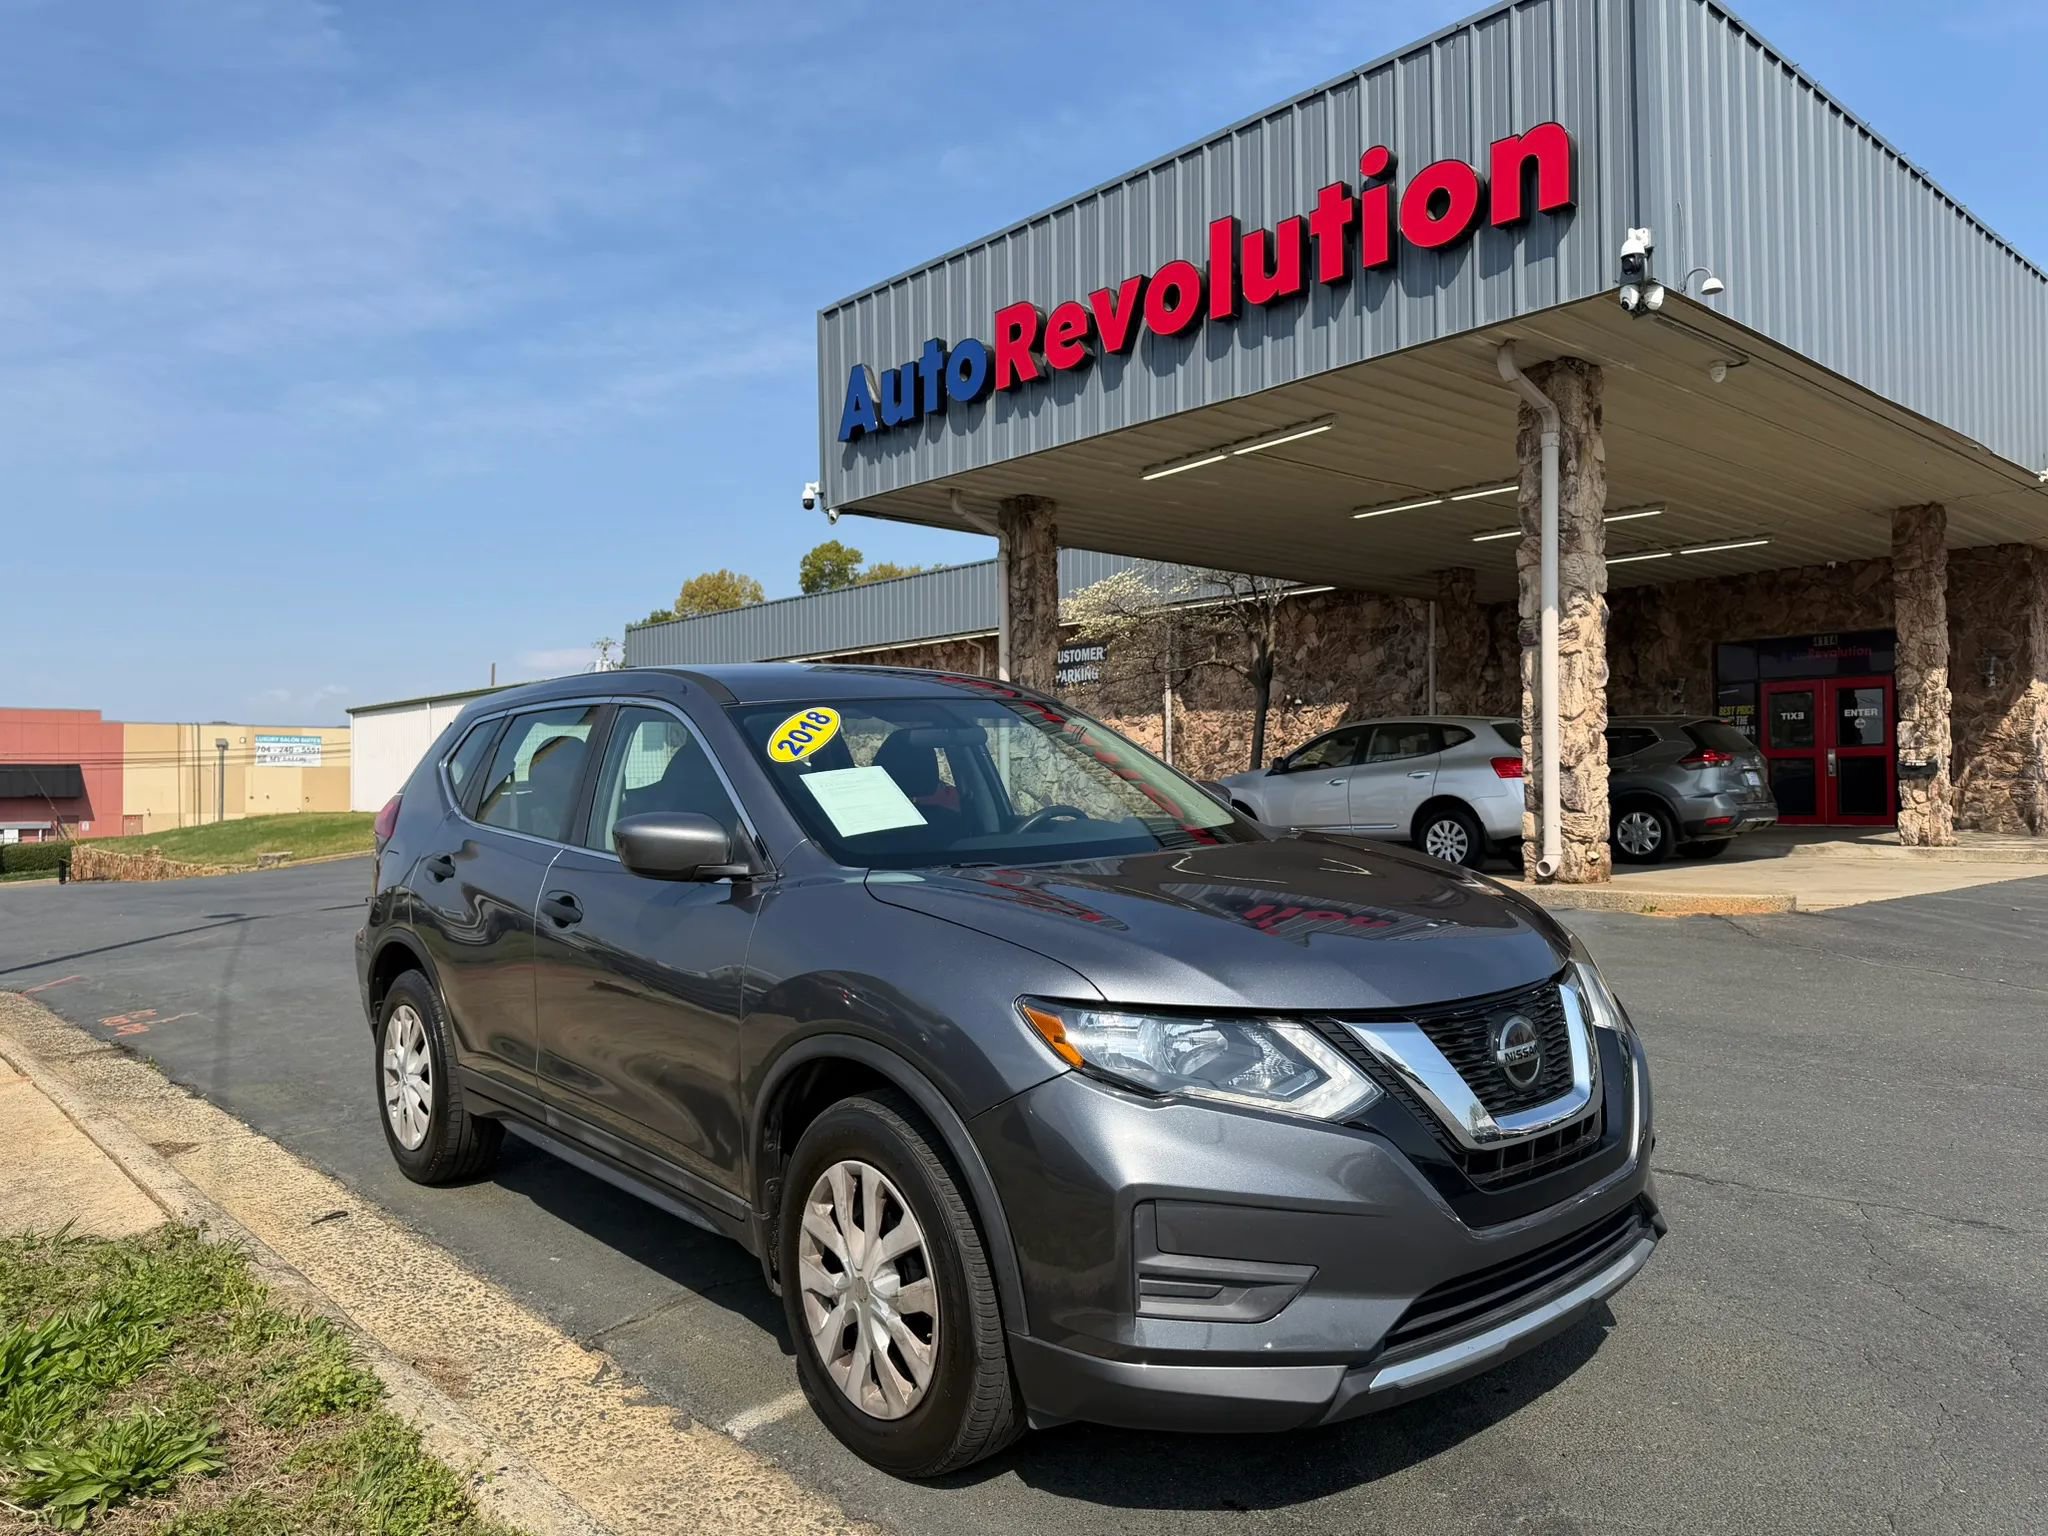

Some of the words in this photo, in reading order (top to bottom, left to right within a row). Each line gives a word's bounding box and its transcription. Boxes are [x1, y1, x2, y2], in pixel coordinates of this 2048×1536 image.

[1057, 646, 1105, 664] USTOMER
[1843, 708, 1878, 717] ENTER
[777, 711, 831, 757] 2018
[1503, 1044, 1538, 1062] NISSAN
